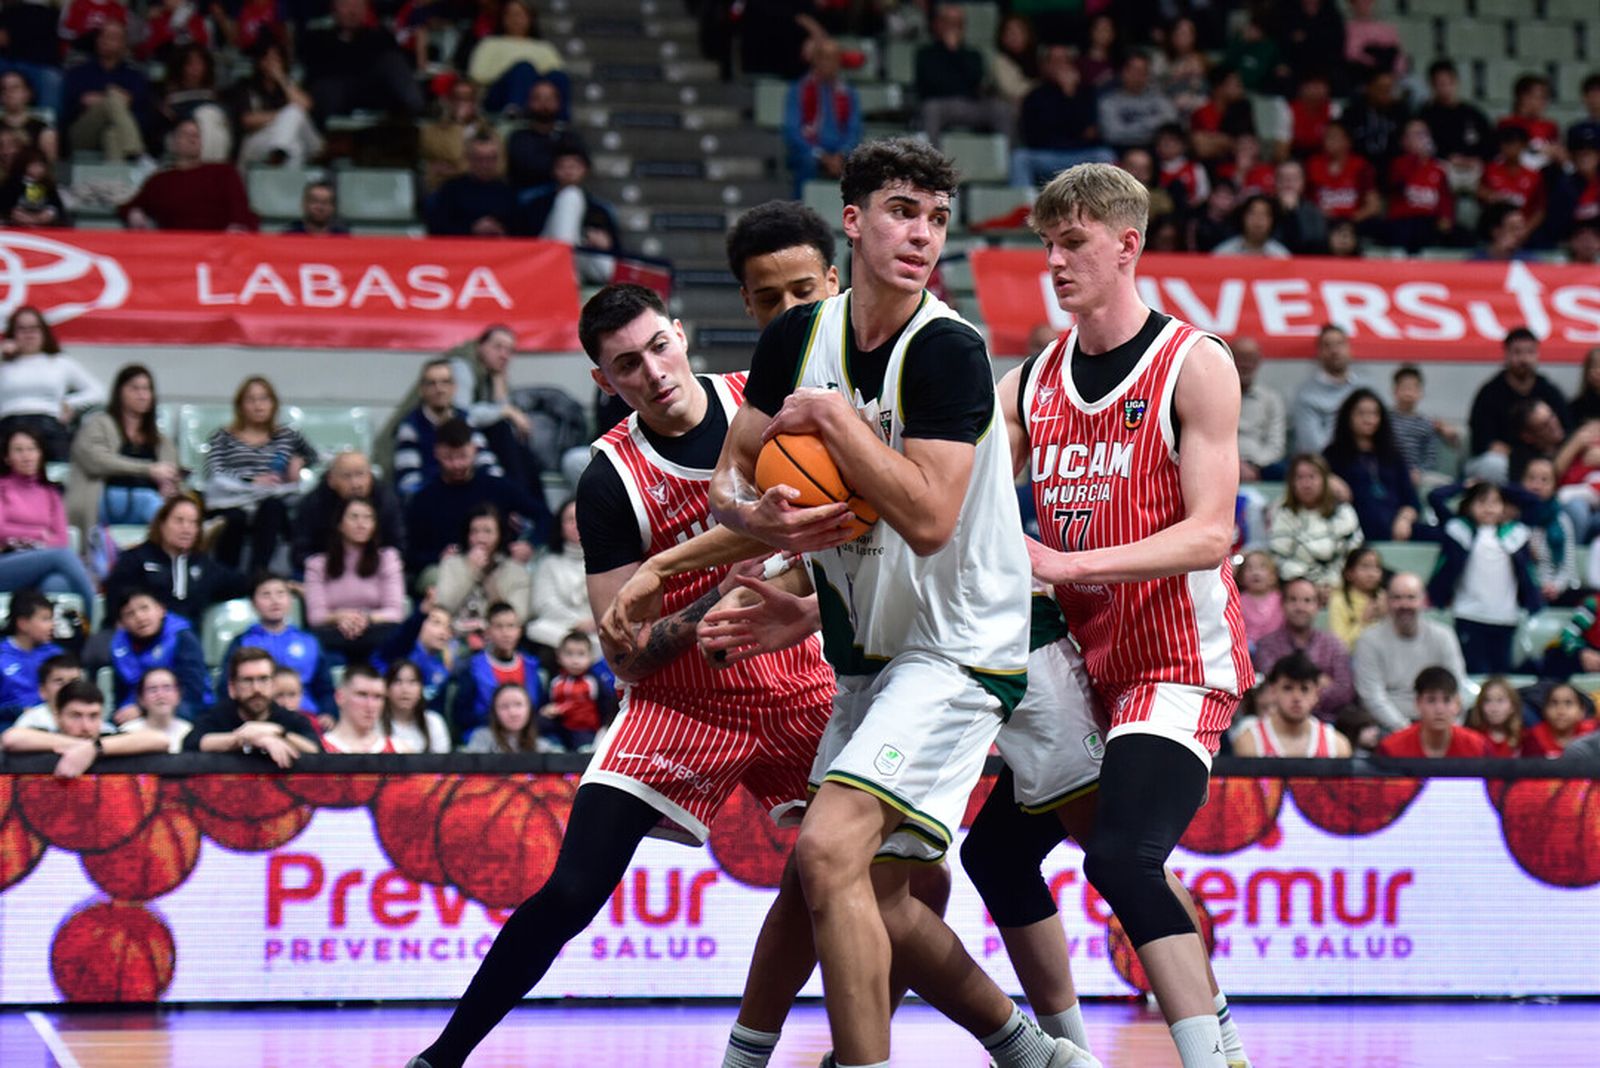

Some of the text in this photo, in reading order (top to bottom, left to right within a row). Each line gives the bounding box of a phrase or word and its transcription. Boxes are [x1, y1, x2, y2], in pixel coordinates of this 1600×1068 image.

[195, 262, 514, 310] LABASA
[1040, 260, 1600, 342] IVERSUS
[1031, 441, 1134, 483] UCAM
[1043, 483, 1111, 506] MURCIA
[1054, 509, 1093, 552] 77
[651, 752, 714, 794] INVERSUS
[266, 853, 718, 928] Prevur
[265, 934, 716, 961] PREVENCIÓ SALUD
[1254, 936, 1270, 958] Y
[1294, 936, 1412, 959] SALUD
